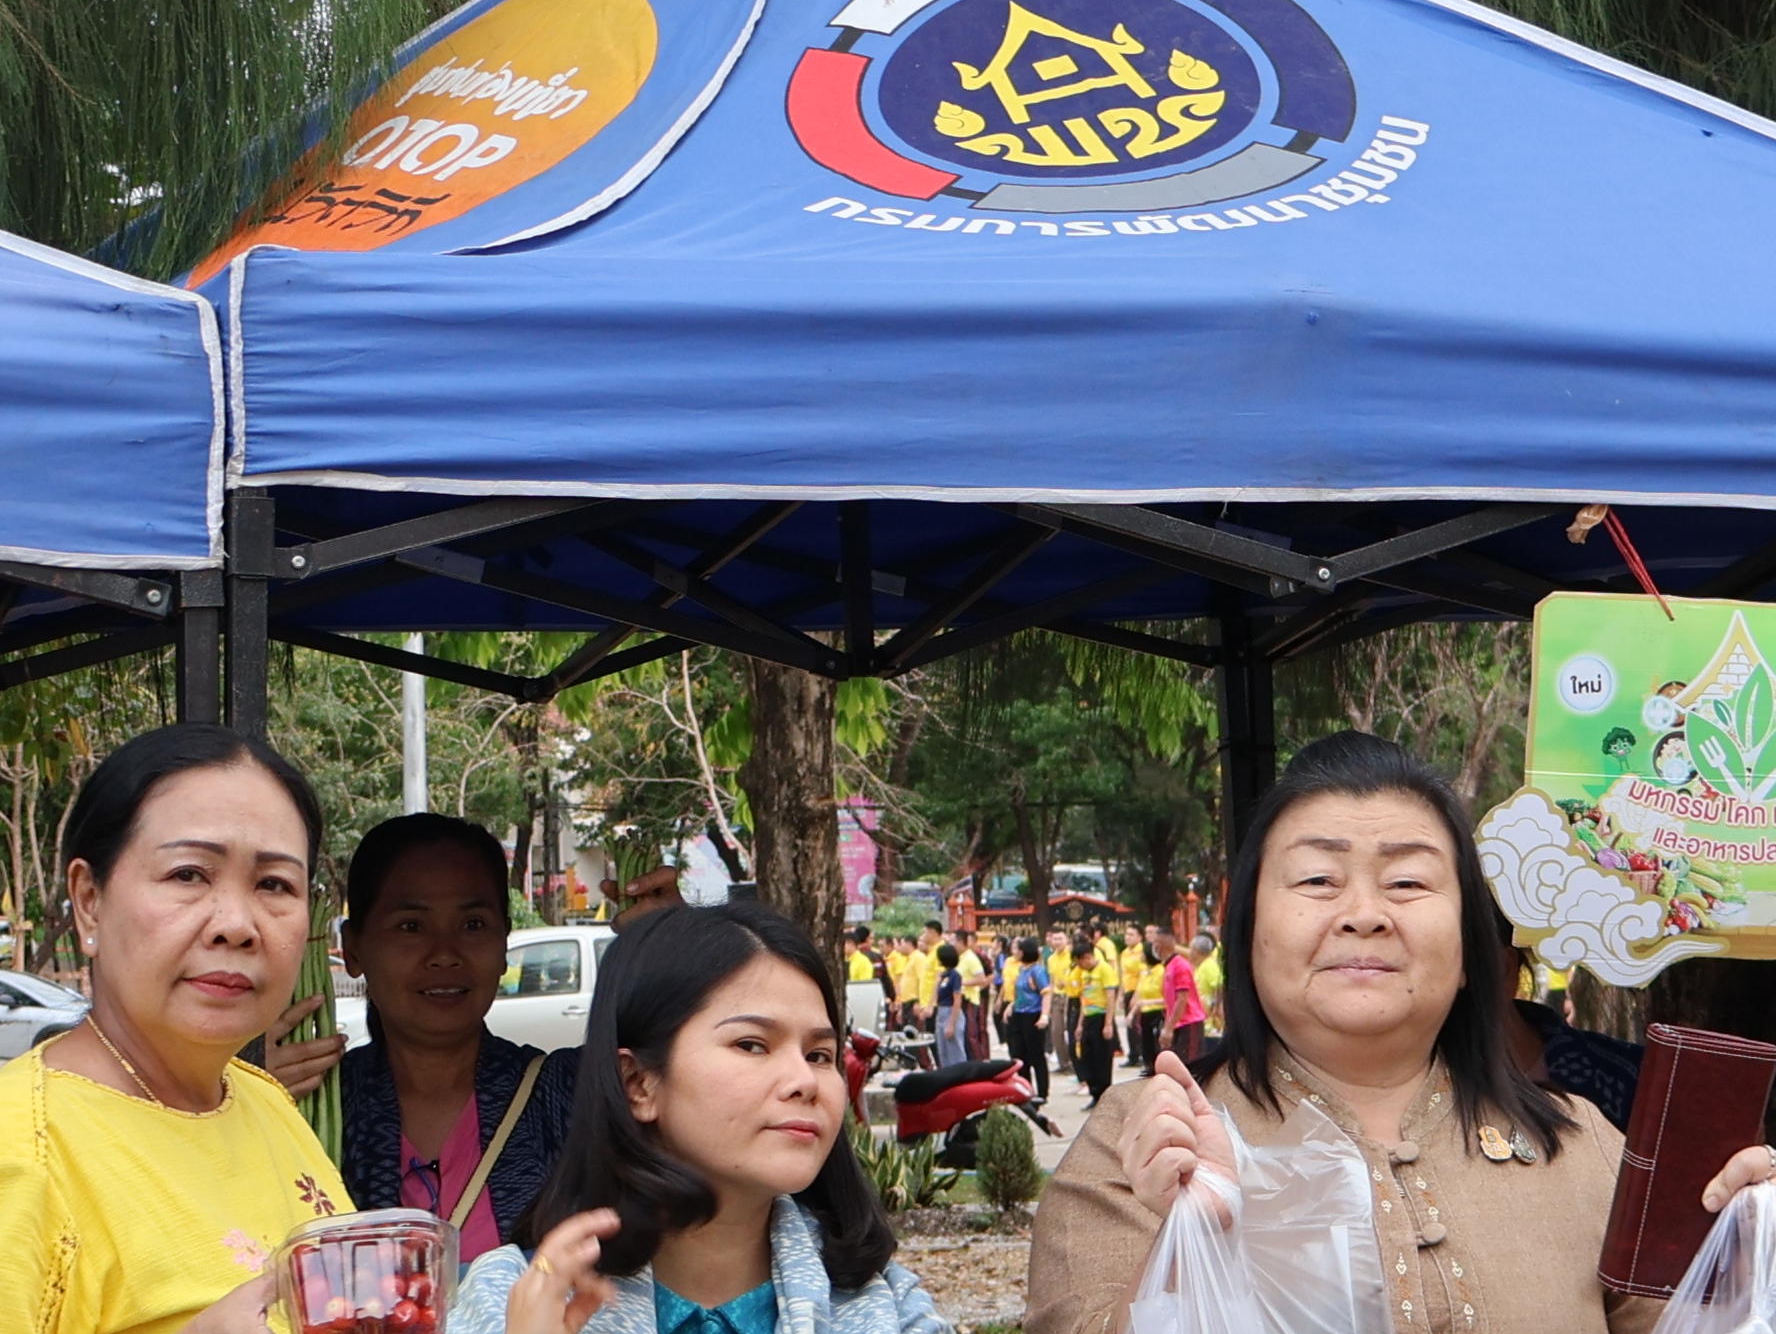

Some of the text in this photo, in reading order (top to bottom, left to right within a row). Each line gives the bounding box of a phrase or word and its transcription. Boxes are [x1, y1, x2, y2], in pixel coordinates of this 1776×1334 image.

[342, 114, 519, 182] OTOP
[803, 114, 1431, 240] กรมการพัฒนาชุมชน
[1569, 674, 1602, 694] ใหม่
[1628, 780, 1723, 821] มหกรรม
[1726, 796, 1767, 825] โคก
